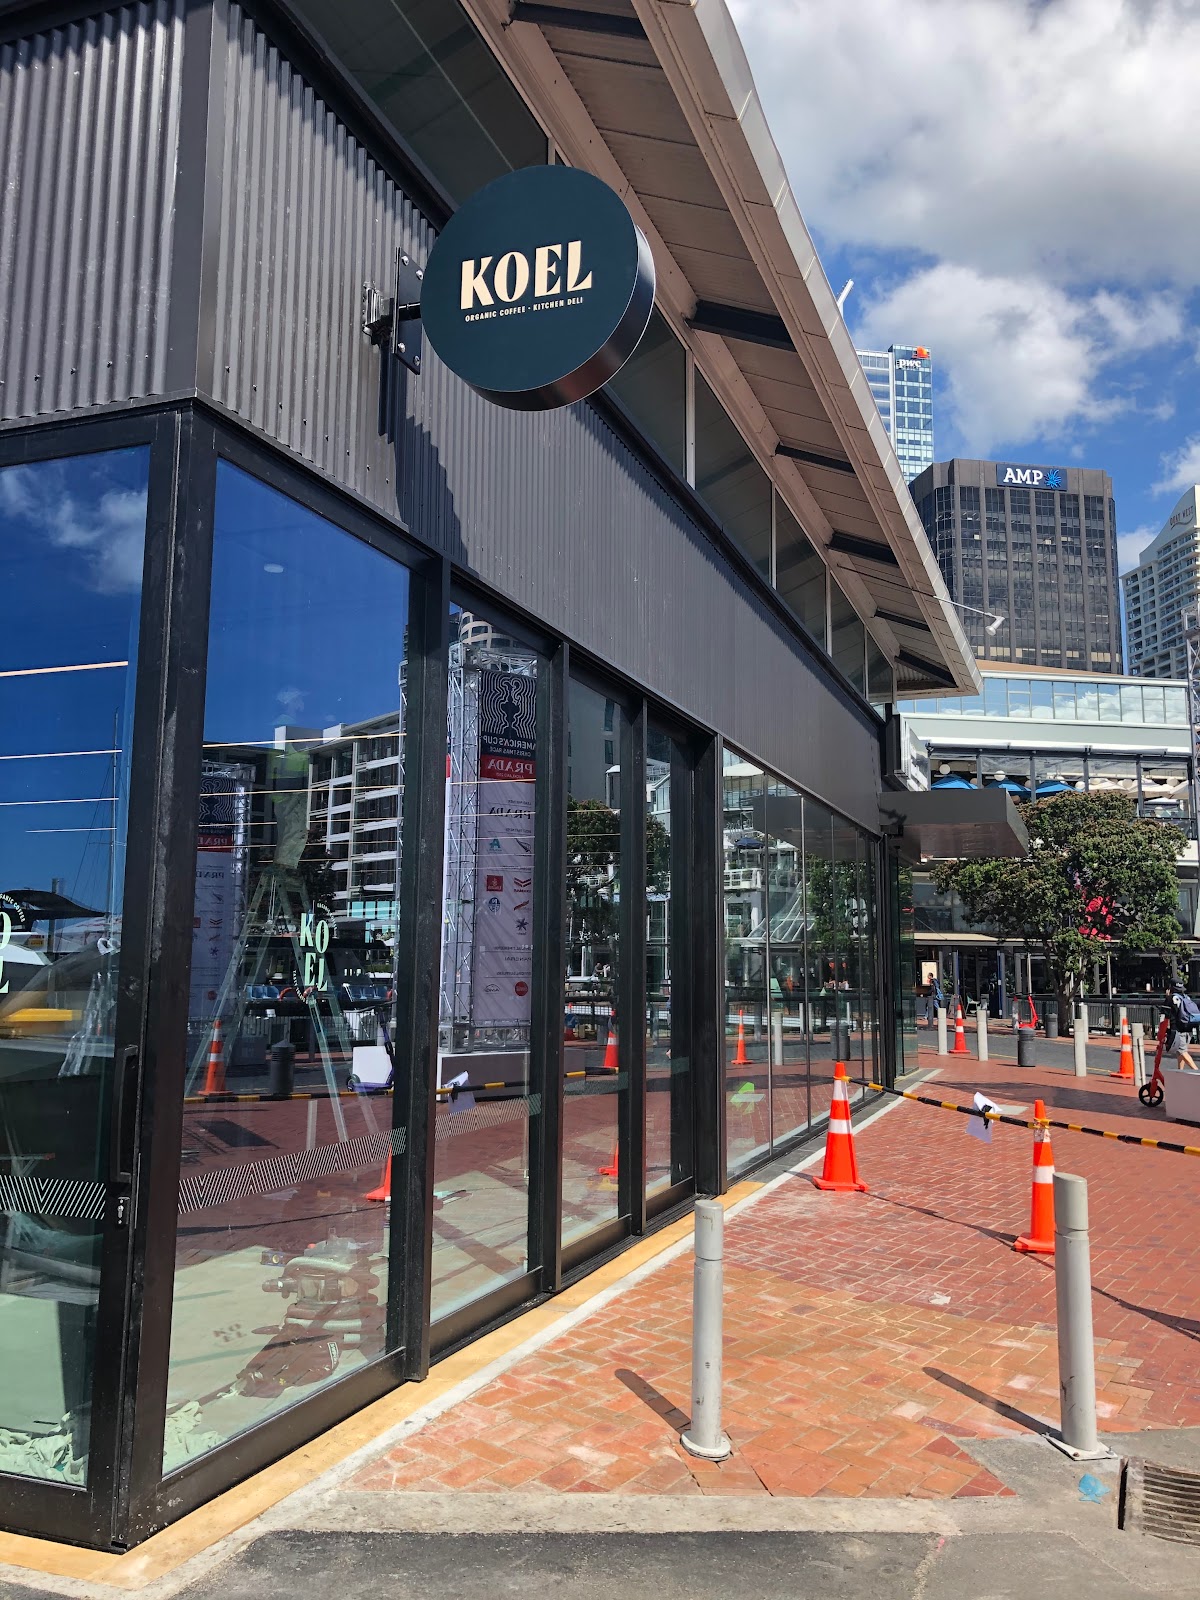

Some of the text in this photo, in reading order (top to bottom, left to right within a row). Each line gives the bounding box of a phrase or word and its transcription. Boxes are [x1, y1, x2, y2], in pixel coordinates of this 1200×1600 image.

[460, 240, 593, 310] KOEL
[465, 297, 583, 322] ORGANIC COFFEE KITCHEN DELI
[899, 359, 922, 369] pwc
[1003, 467, 1043, 485] AMP
[299, 912, 330, 954] KO
[304, 952, 328, 992] EL
